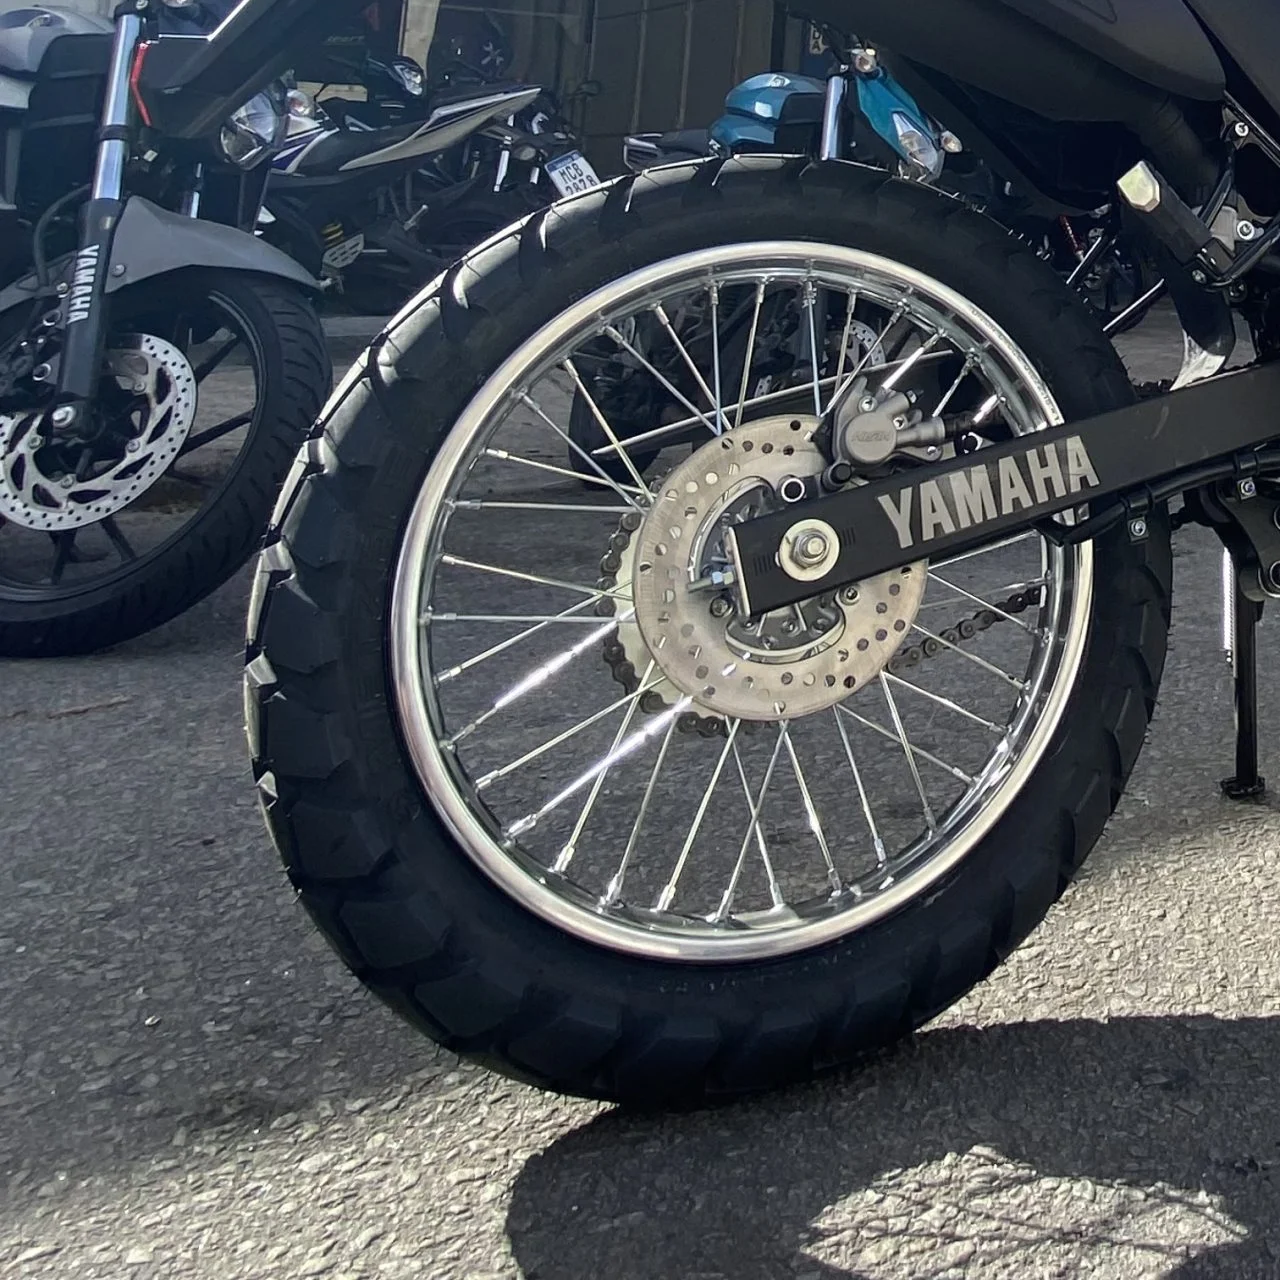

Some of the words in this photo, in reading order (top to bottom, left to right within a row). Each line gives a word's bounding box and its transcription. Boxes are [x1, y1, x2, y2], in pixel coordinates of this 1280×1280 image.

[558, 162, 584, 185] MCB
[66, 244, 100, 325] YAMAHA
[877, 434, 1100, 549] YAMAHA
